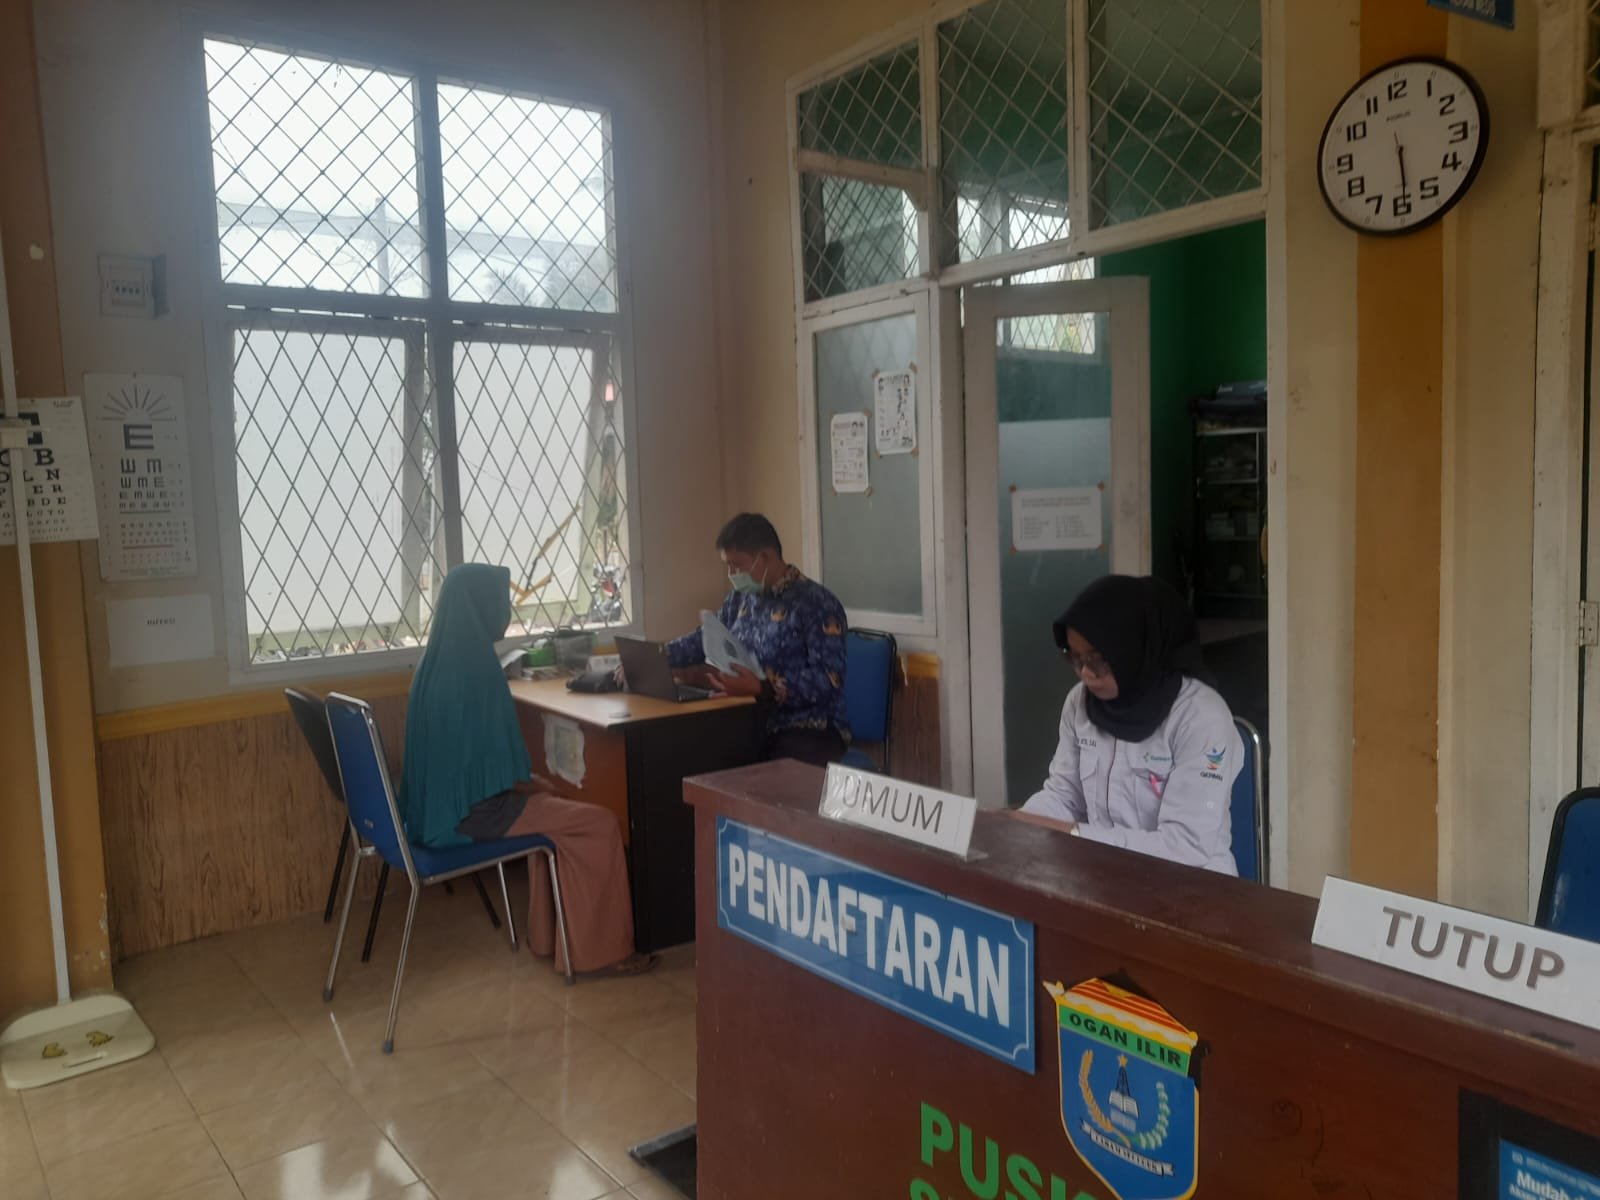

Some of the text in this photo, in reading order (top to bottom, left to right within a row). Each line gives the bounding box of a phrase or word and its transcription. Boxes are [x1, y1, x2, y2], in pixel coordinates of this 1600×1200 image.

[1387, 79, 1408, 101] 12
[1426, 79, 1433, 97] 1
[1366, 96, 1379, 116] 11
[1439, 94, 1456, 116] 2
[1346, 121, 1368, 142] 10
[1448, 120, 1469, 144] 3
[1336, 153, 1354, 175] 9
[1441, 151, 1462, 172] 4
[1347, 176, 1365, 198] 8
[1419, 176, 1440, 200] 5
[1365, 194, 1383, 215] 7
[1393, 194, 1412, 217] 6
[123, 424, 155, 450] E
[33, 448, 55, 466] B
[45, 468, 60, 481] N
[842, 775, 943, 834] UMUM
[729, 843, 1010, 1028] PENDAFTARAN
[1382, 905, 1566, 990] TUTUP
[1069, 1013, 1182, 1067] OGAN ILIR
